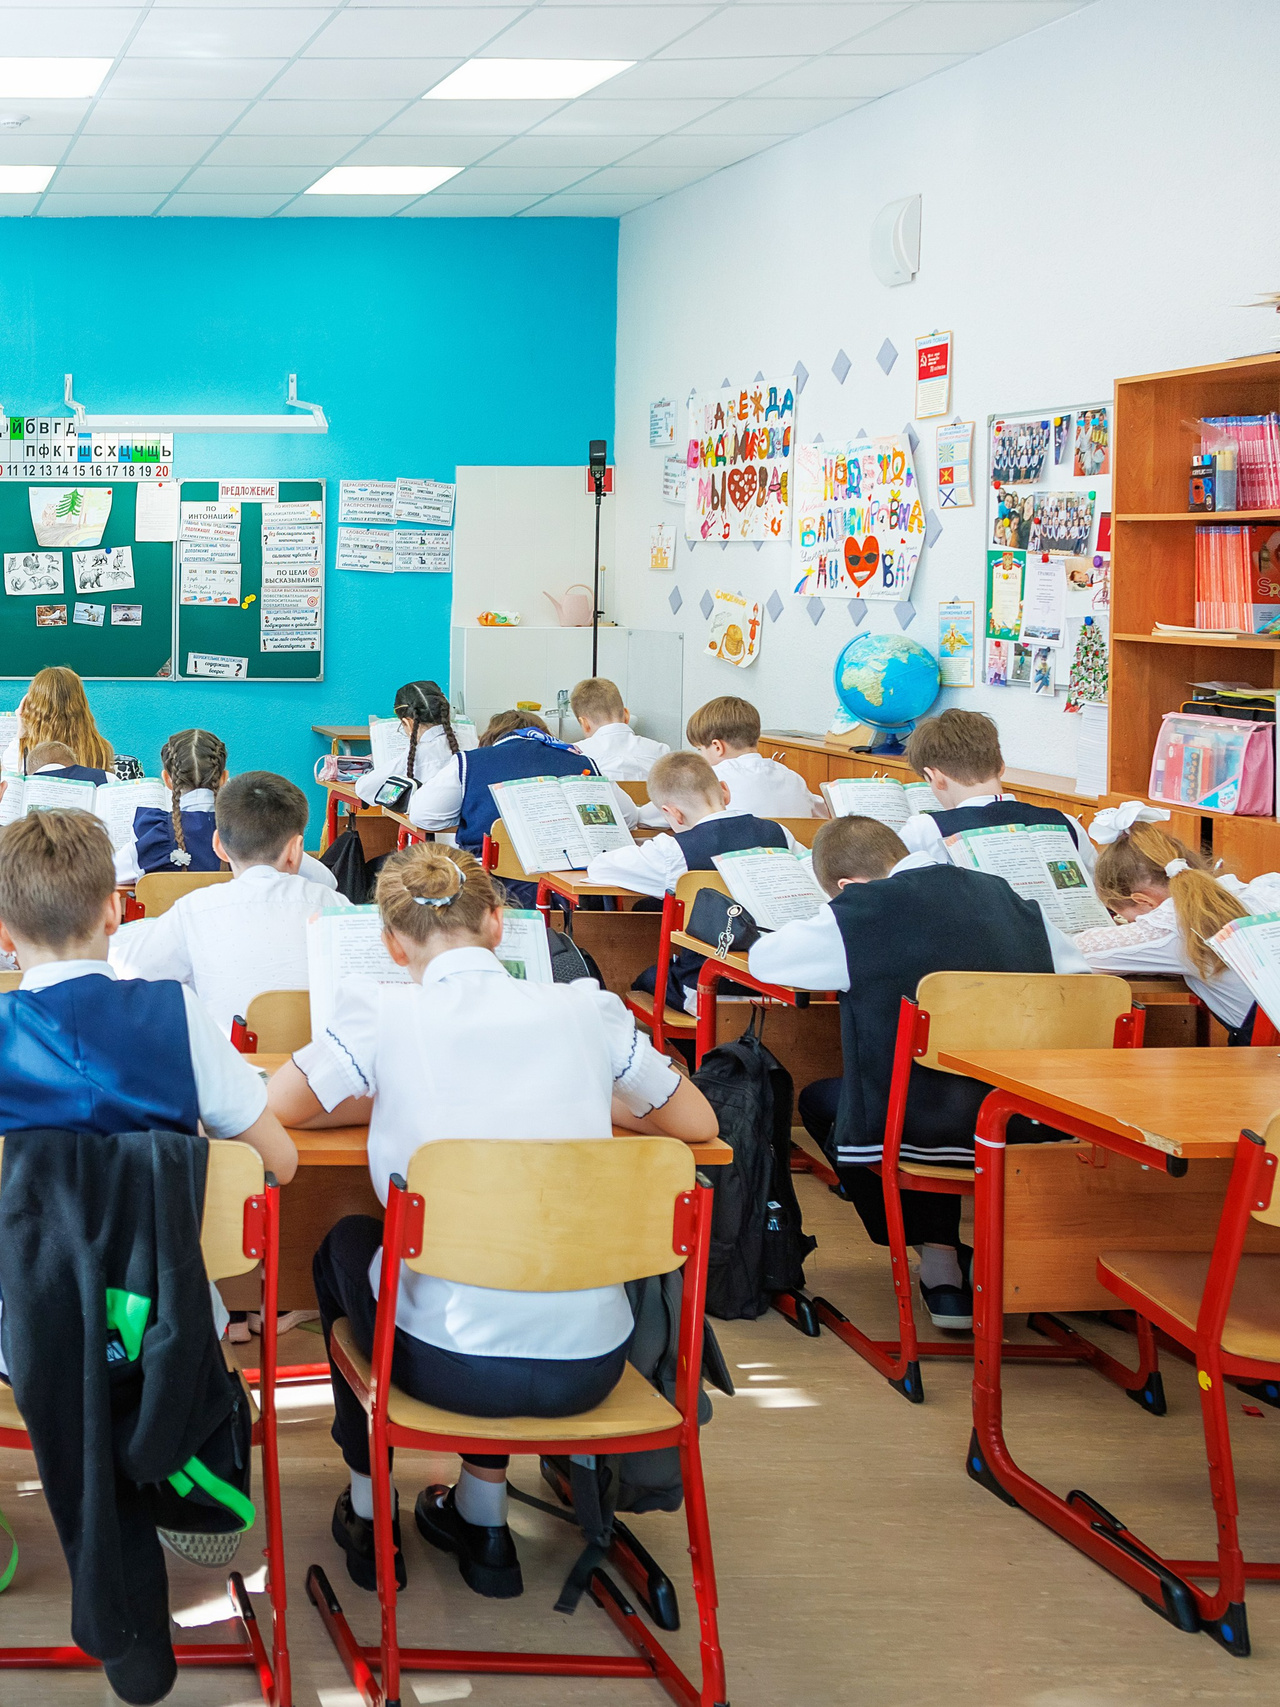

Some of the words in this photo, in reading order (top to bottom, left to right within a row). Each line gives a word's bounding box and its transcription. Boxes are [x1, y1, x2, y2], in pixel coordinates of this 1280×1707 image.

[12, 419, 22, 434] й
[25, 418, 36, 434] б
[39, 422, 49, 434] в
[54, 422, 61, 434] г
[26, 445, 35, 457] п
[38, 443, 50, 458] ф
[53, 445, 62, 457] к
[66, 445, 76, 457] т
[79, 445, 90, 457] ш
[93, 445, 103, 457] с
[107, 445, 117, 457] х
[120, 445, 131, 460] ц
[134, 445, 144, 457] ч
[147, 445, 159, 460] щ
[162, 445, 171, 457] ь
[7, 464, 18, 477] 11
[23, 464, 36, 477] 12
[40, 464, 52, 477] 13
[56, 464, 69, 477] 14
[73, 464, 86, 477] 15
[90, 464, 102, 477] 16
[106, 464, 119, 477] 17
[123, 464, 135, 477] 18
[139, 464, 152, 477] 19
[155, 464, 169, 477] 20
[221, 485, 275, 496] ПРЕДЛОЖЕНИЕ
[288, 569, 308, 577] ЦЕЛИ
[1257, 577, 1280, 597] Sp
